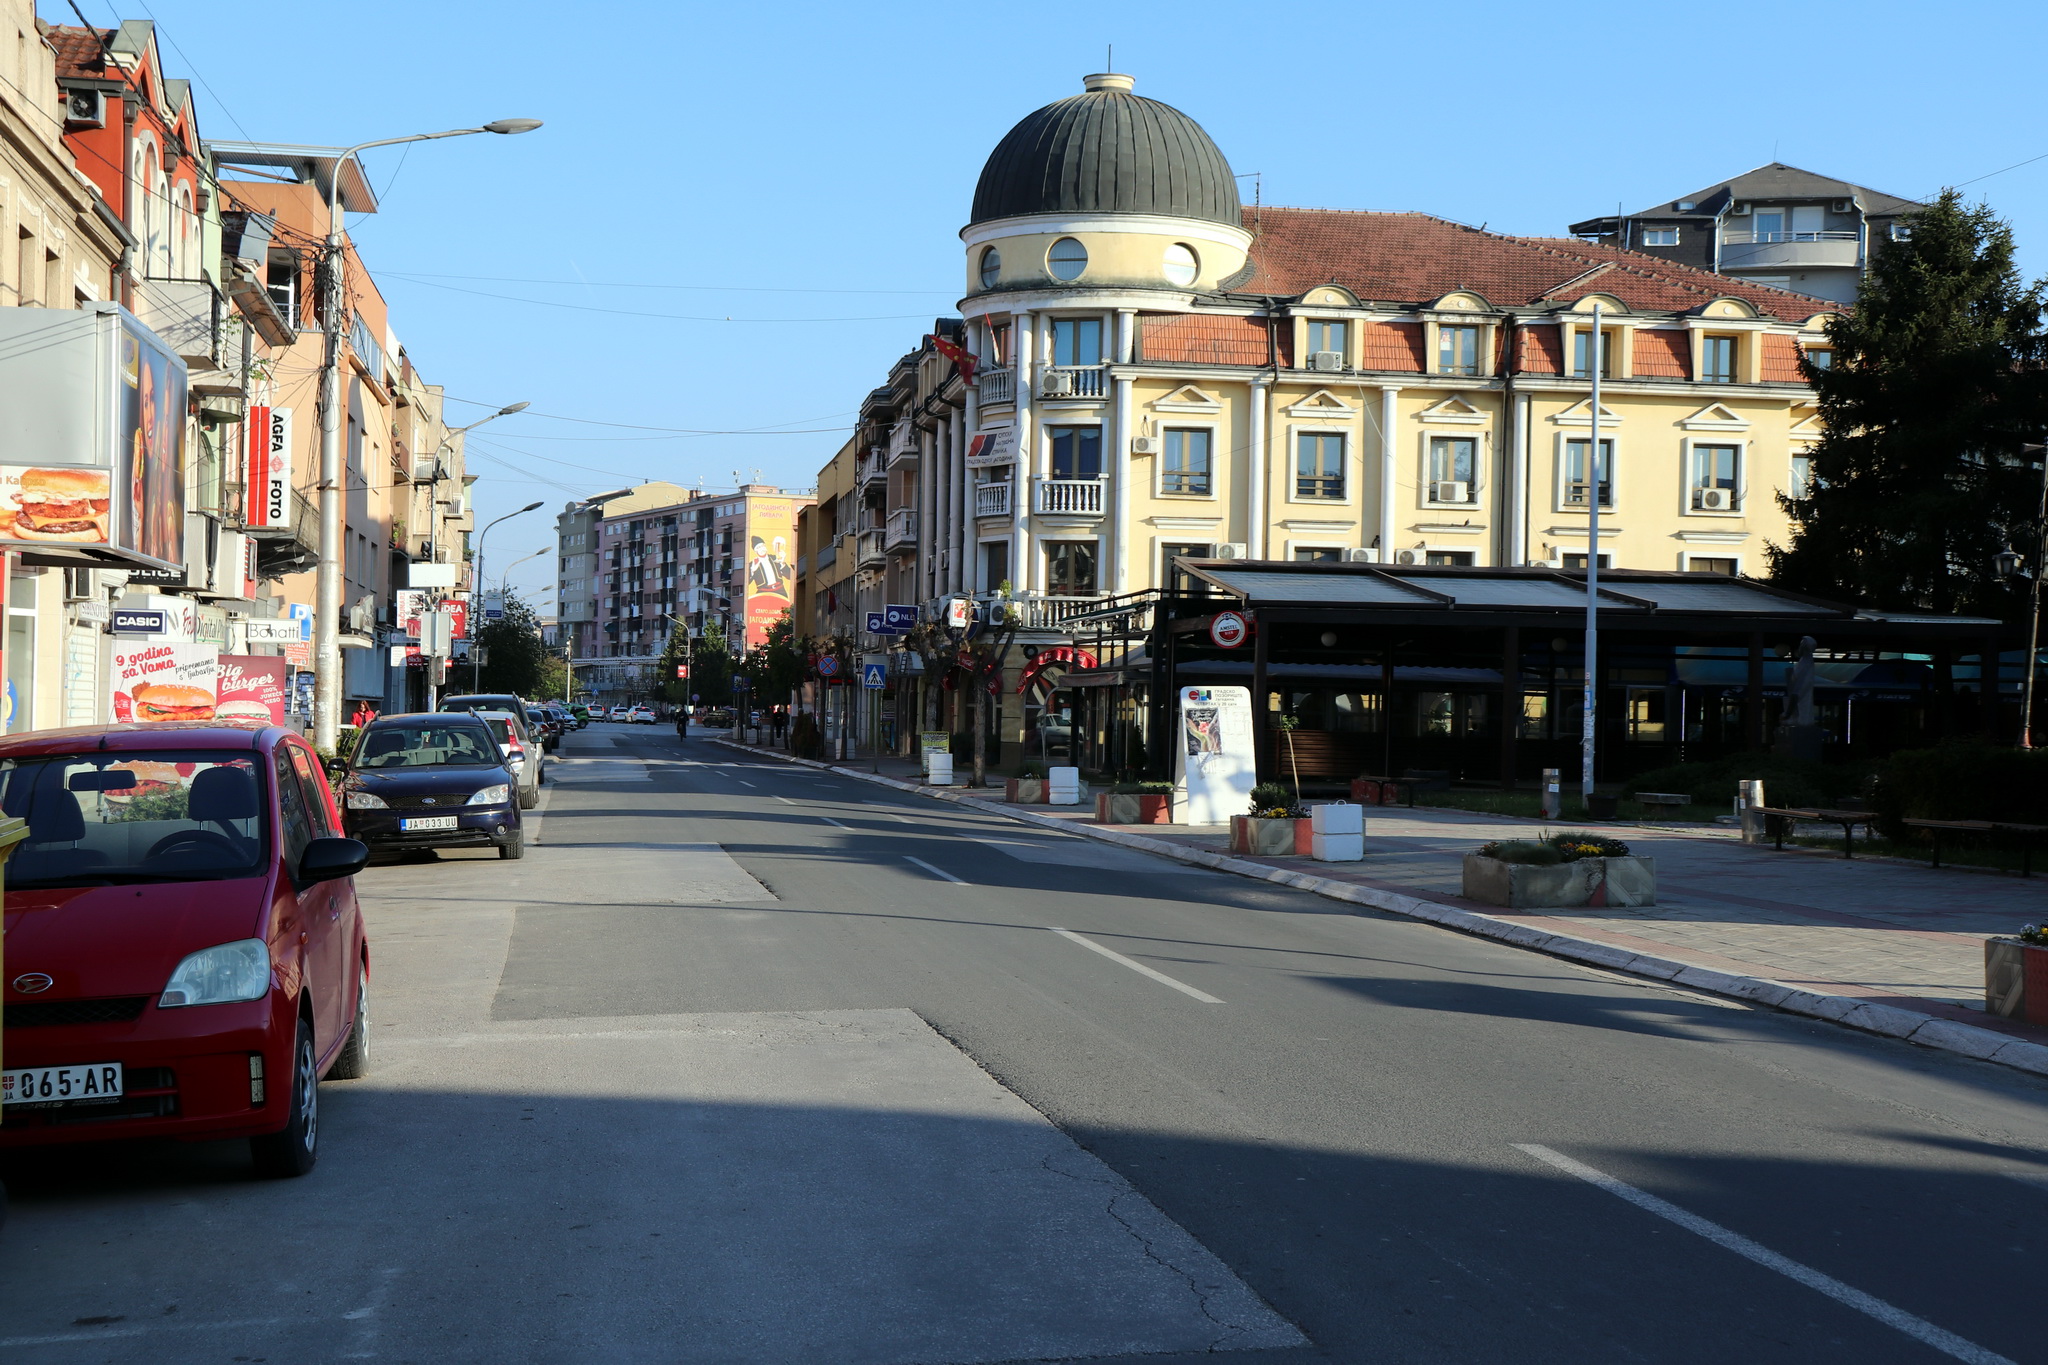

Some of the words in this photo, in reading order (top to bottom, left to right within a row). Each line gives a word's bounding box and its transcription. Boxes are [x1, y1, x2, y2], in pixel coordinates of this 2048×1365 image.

[272, 414, 284, 452] AGFA
[270, 480, 282, 519] FOTO
[295, 606, 307, 619] P
[117, 616, 160, 627] CASIO
[250, 624, 299, 638] Bonatti
[116, 655, 125, 667] 9
[129, 646, 174, 667] godina
[122, 668, 138, 679] sa
[141, 659, 177, 676] Vama
[175, 658, 215, 675] pripremamo
[187, 668, 216, 680] ljubavlju
[217, 664, 244, 680] Big
[222, 673, 275, 692] burger
[408, 820, 419, 829] JA
